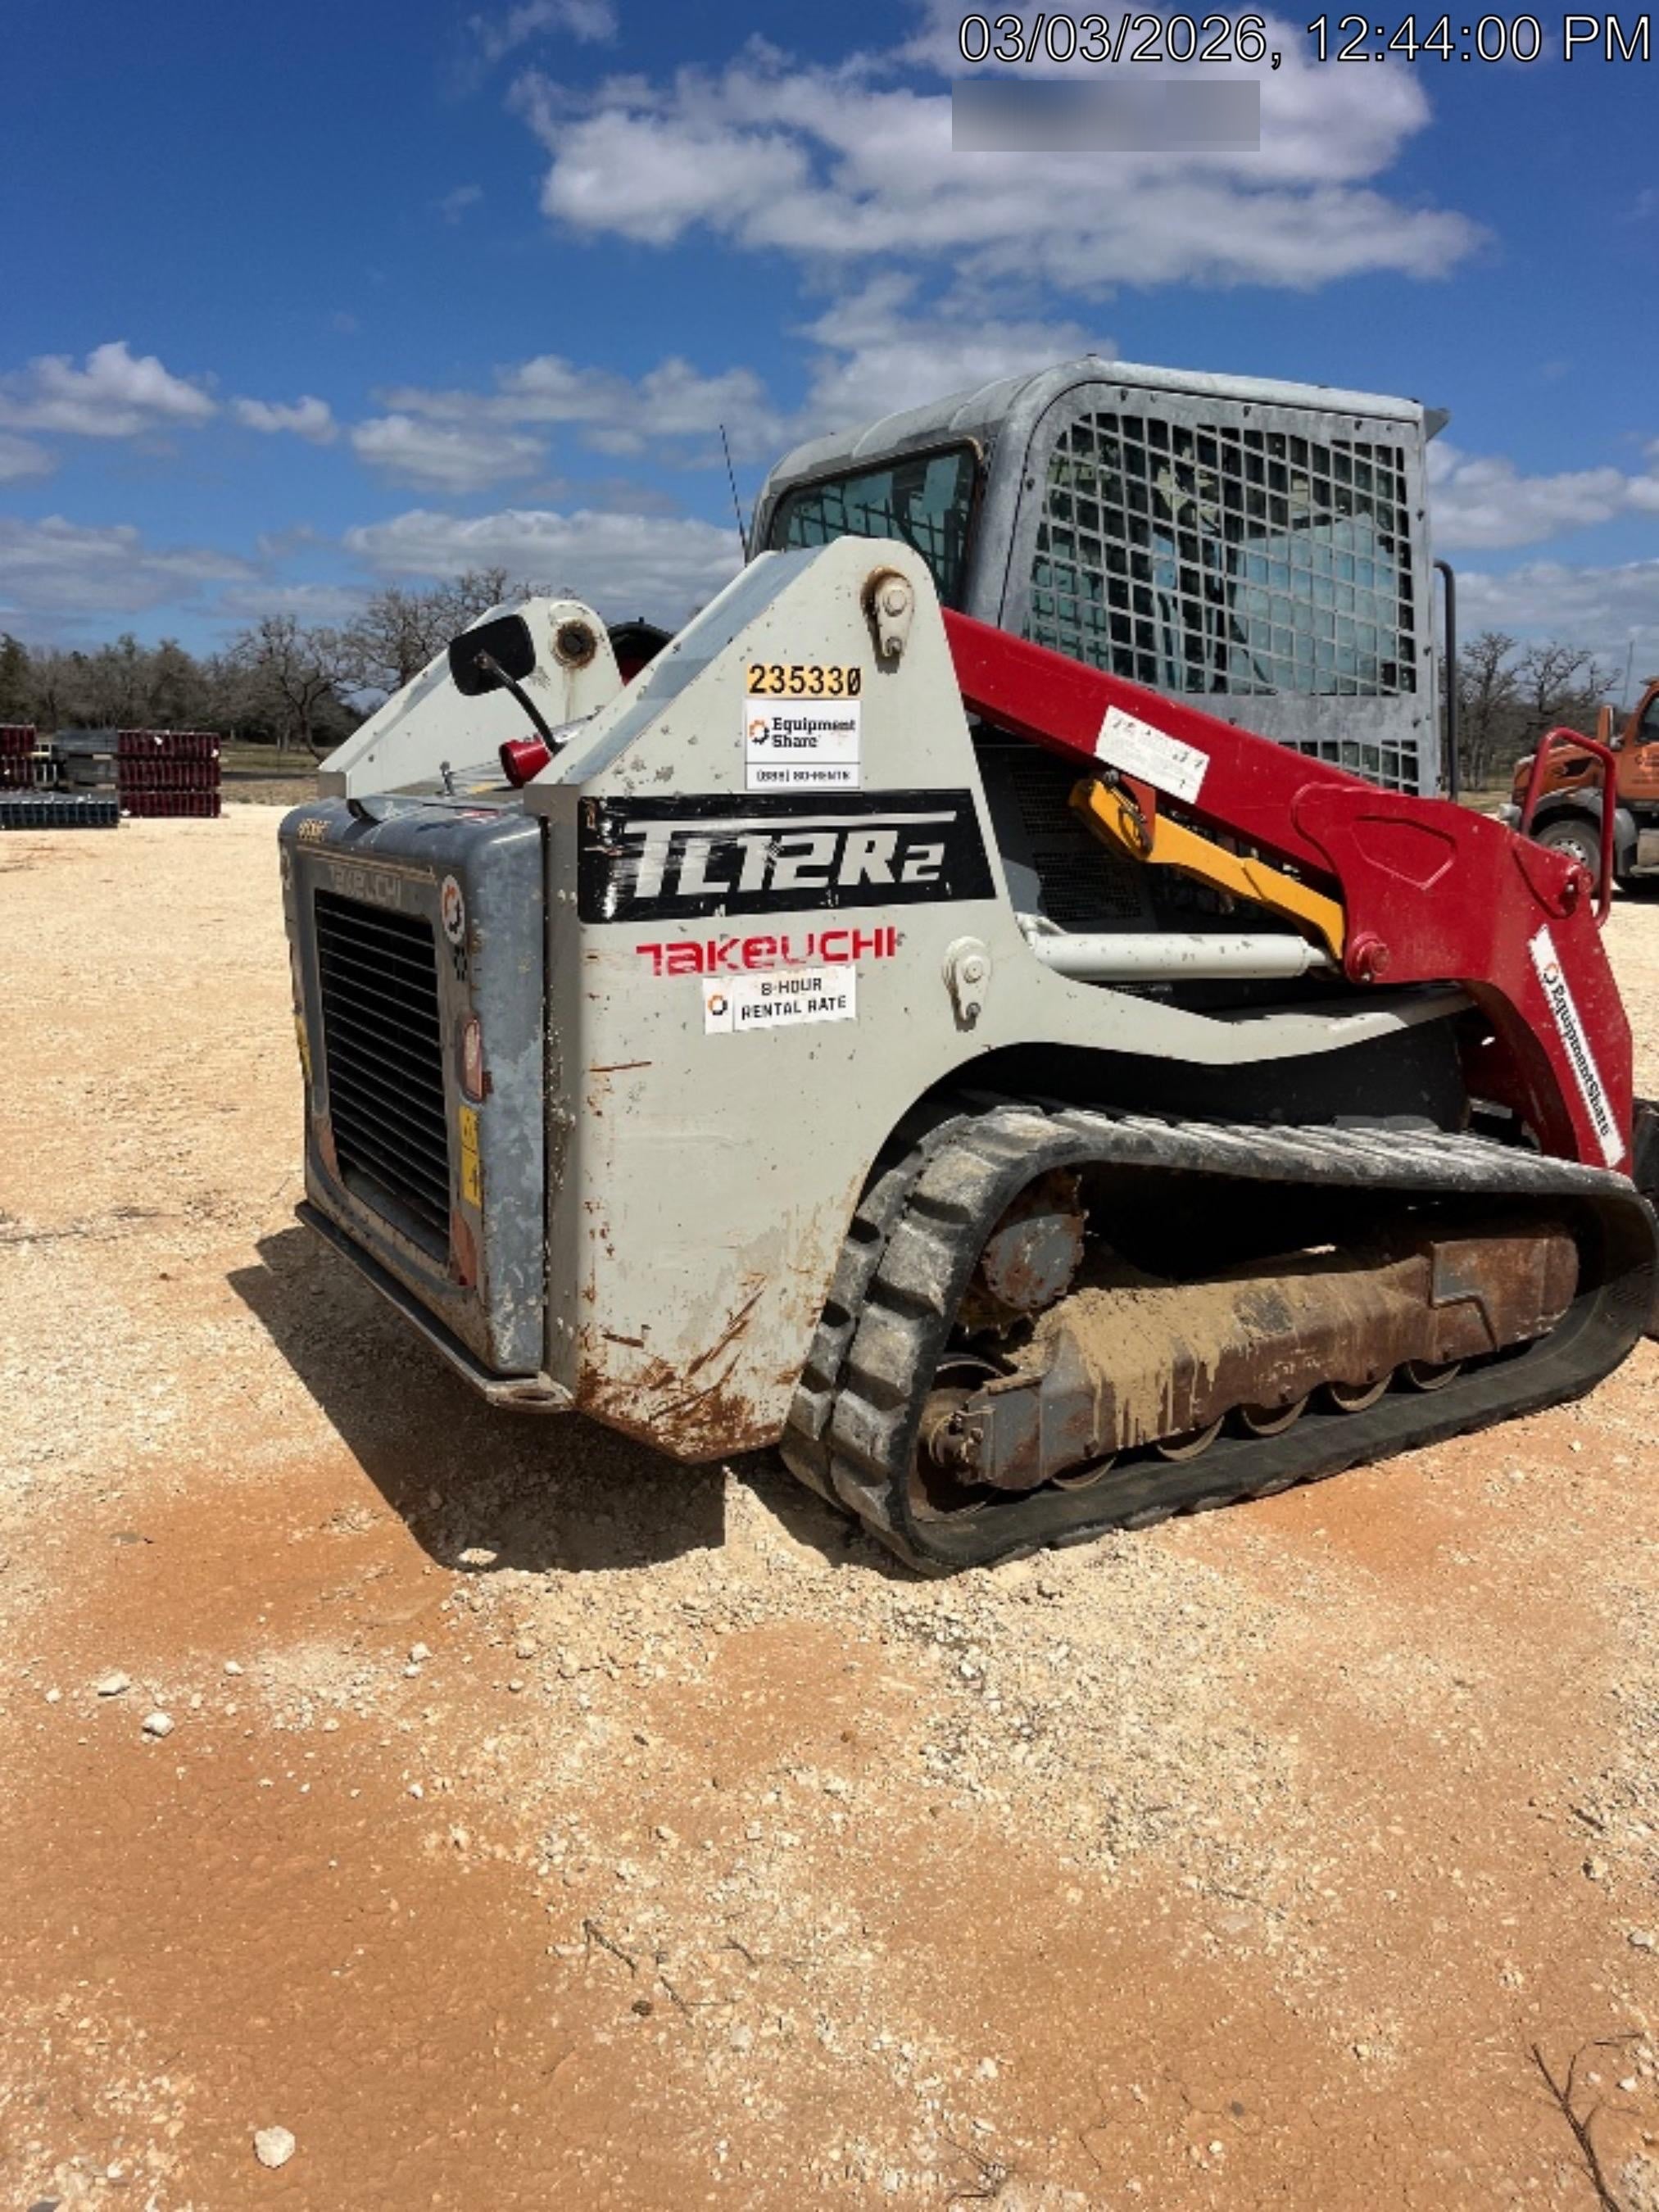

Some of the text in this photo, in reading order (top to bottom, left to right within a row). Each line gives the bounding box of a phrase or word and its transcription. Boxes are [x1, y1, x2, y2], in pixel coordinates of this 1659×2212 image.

[749, 664, 861, 696] 235330
[773, 717, 855, 735] Equipment
[773, 733, 817, 748] Share
[624, 810, 957, 898] TL12R2
[741, 995, 846, 1021] RENTAL RATE
[1550, 984, 1611, 1136] EquipmentShare
